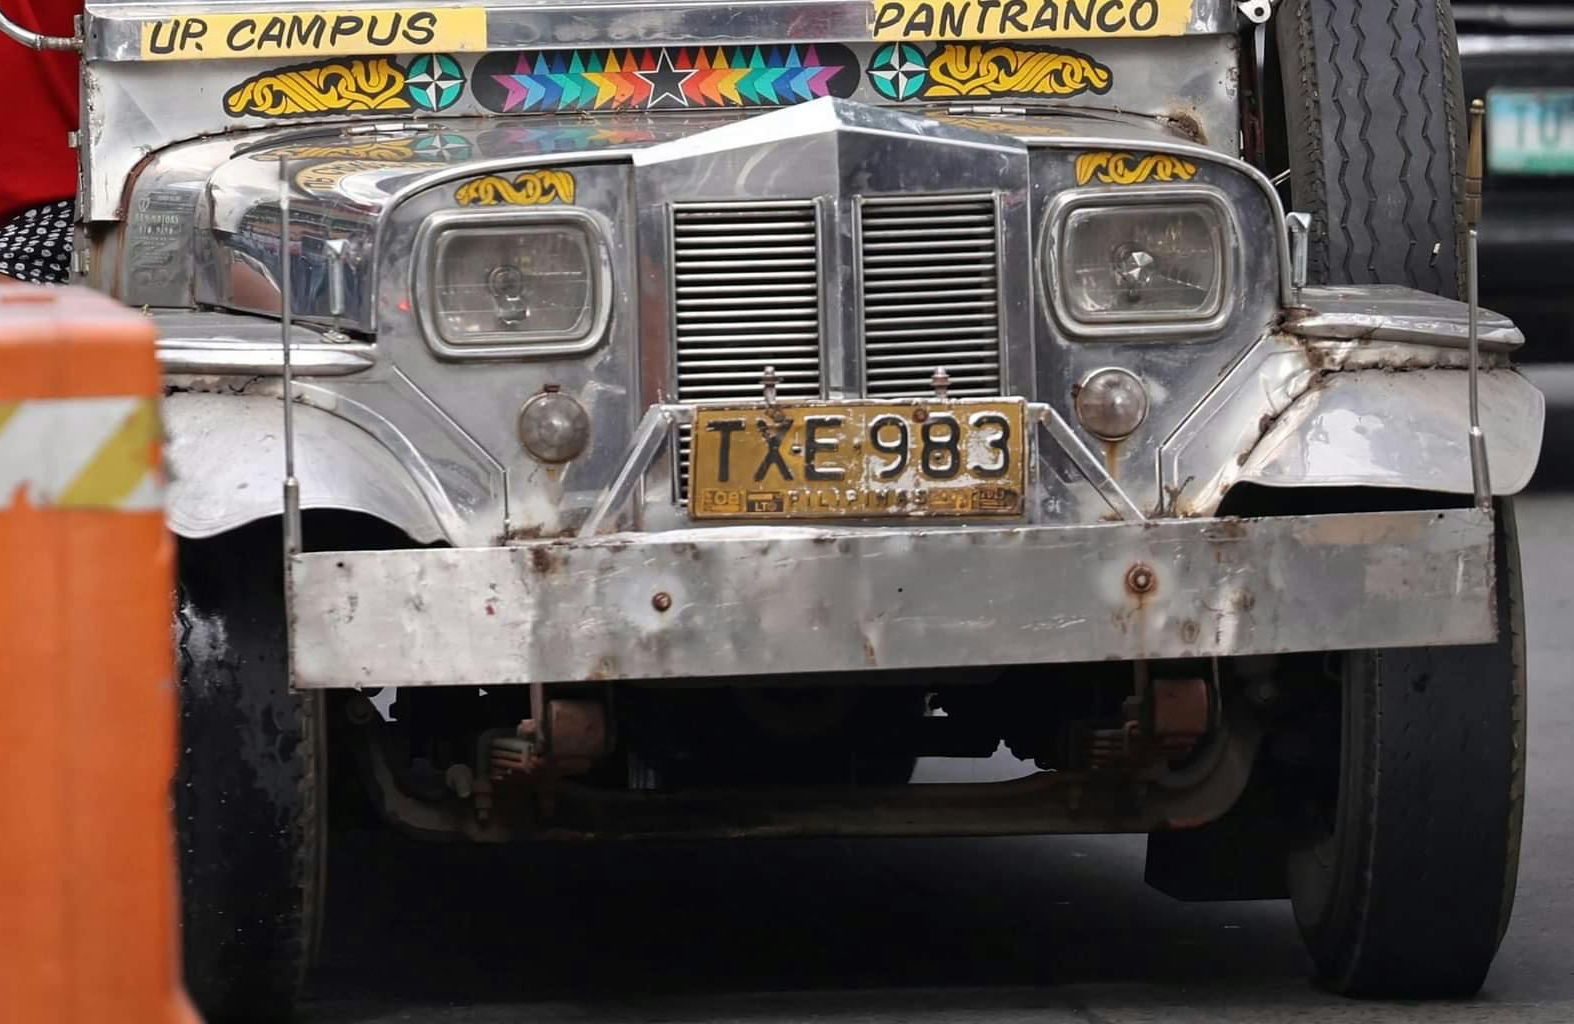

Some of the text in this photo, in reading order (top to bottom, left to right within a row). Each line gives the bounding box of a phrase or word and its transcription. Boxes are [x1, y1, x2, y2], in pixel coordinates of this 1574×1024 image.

[225, 11, 438, 52] CAMPUS
[706, 413, 1011, 482] TXE 983
